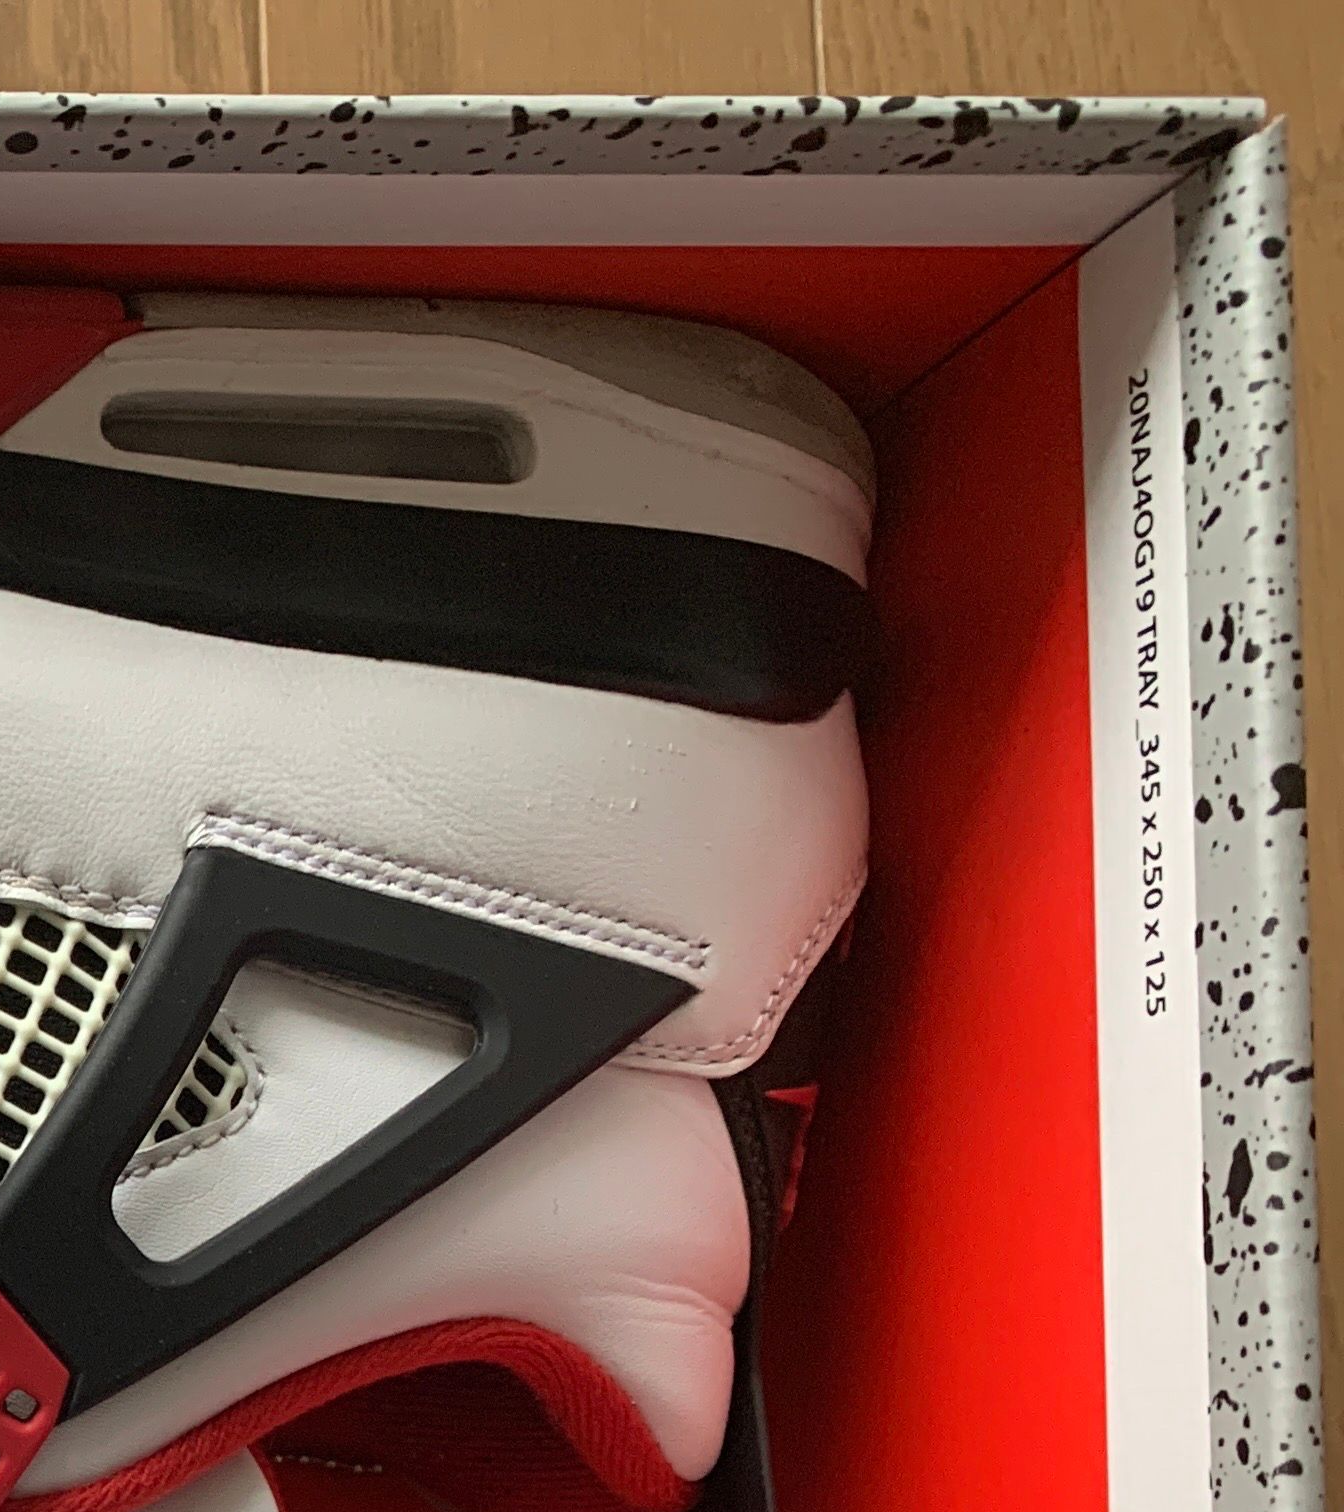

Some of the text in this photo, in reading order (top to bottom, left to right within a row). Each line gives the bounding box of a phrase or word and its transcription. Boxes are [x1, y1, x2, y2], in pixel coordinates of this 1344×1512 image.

[1142, 812, 1158, 836] x
[1143, 841, 1164, 911] 250
[1144, 919, 1160, 942] x
[1145, 951, 1167, 1017] 125
